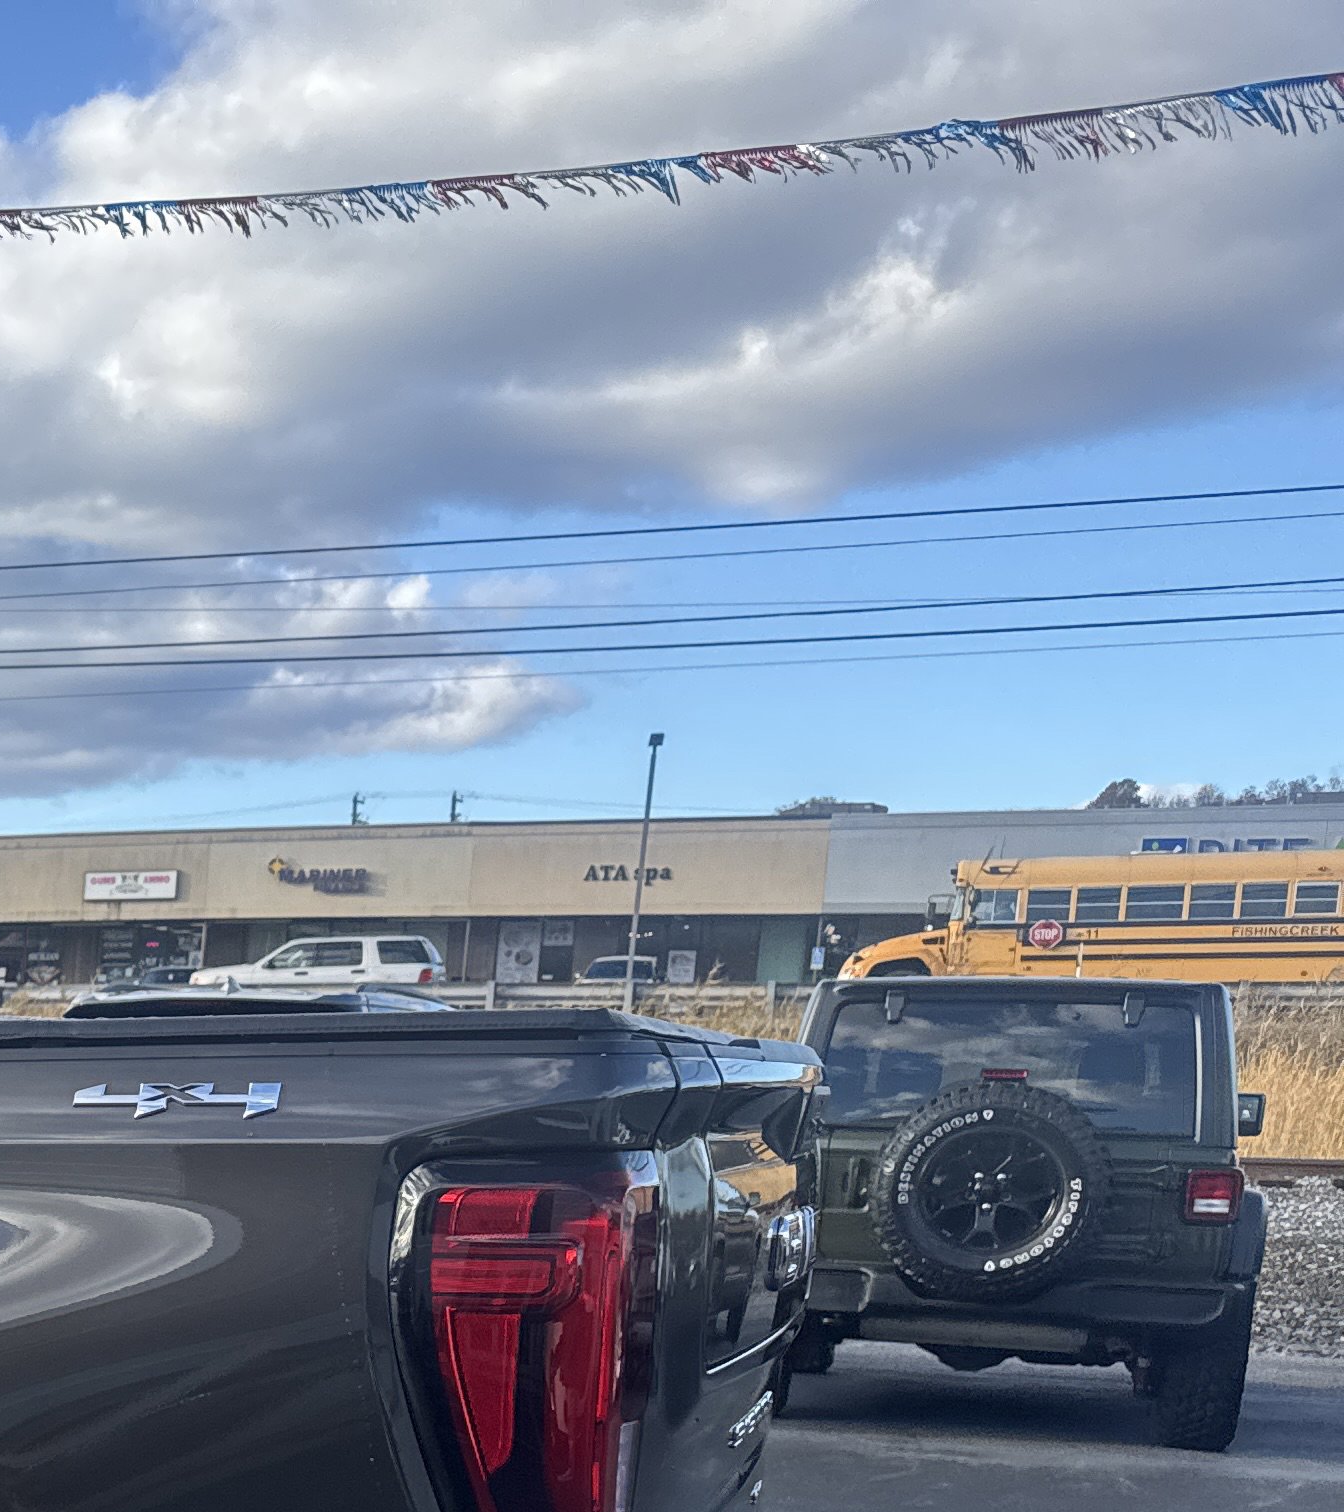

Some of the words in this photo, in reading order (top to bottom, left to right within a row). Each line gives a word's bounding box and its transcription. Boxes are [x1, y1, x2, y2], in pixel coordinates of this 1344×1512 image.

[279, 868, 367, 882] MARINER
[583, 864, 629, 881] ATA
[633, 867, 673, 886] spa
[1034, 928, 1058, 939] STOP
[897, 1111, 979, 1205] DESTINATION
